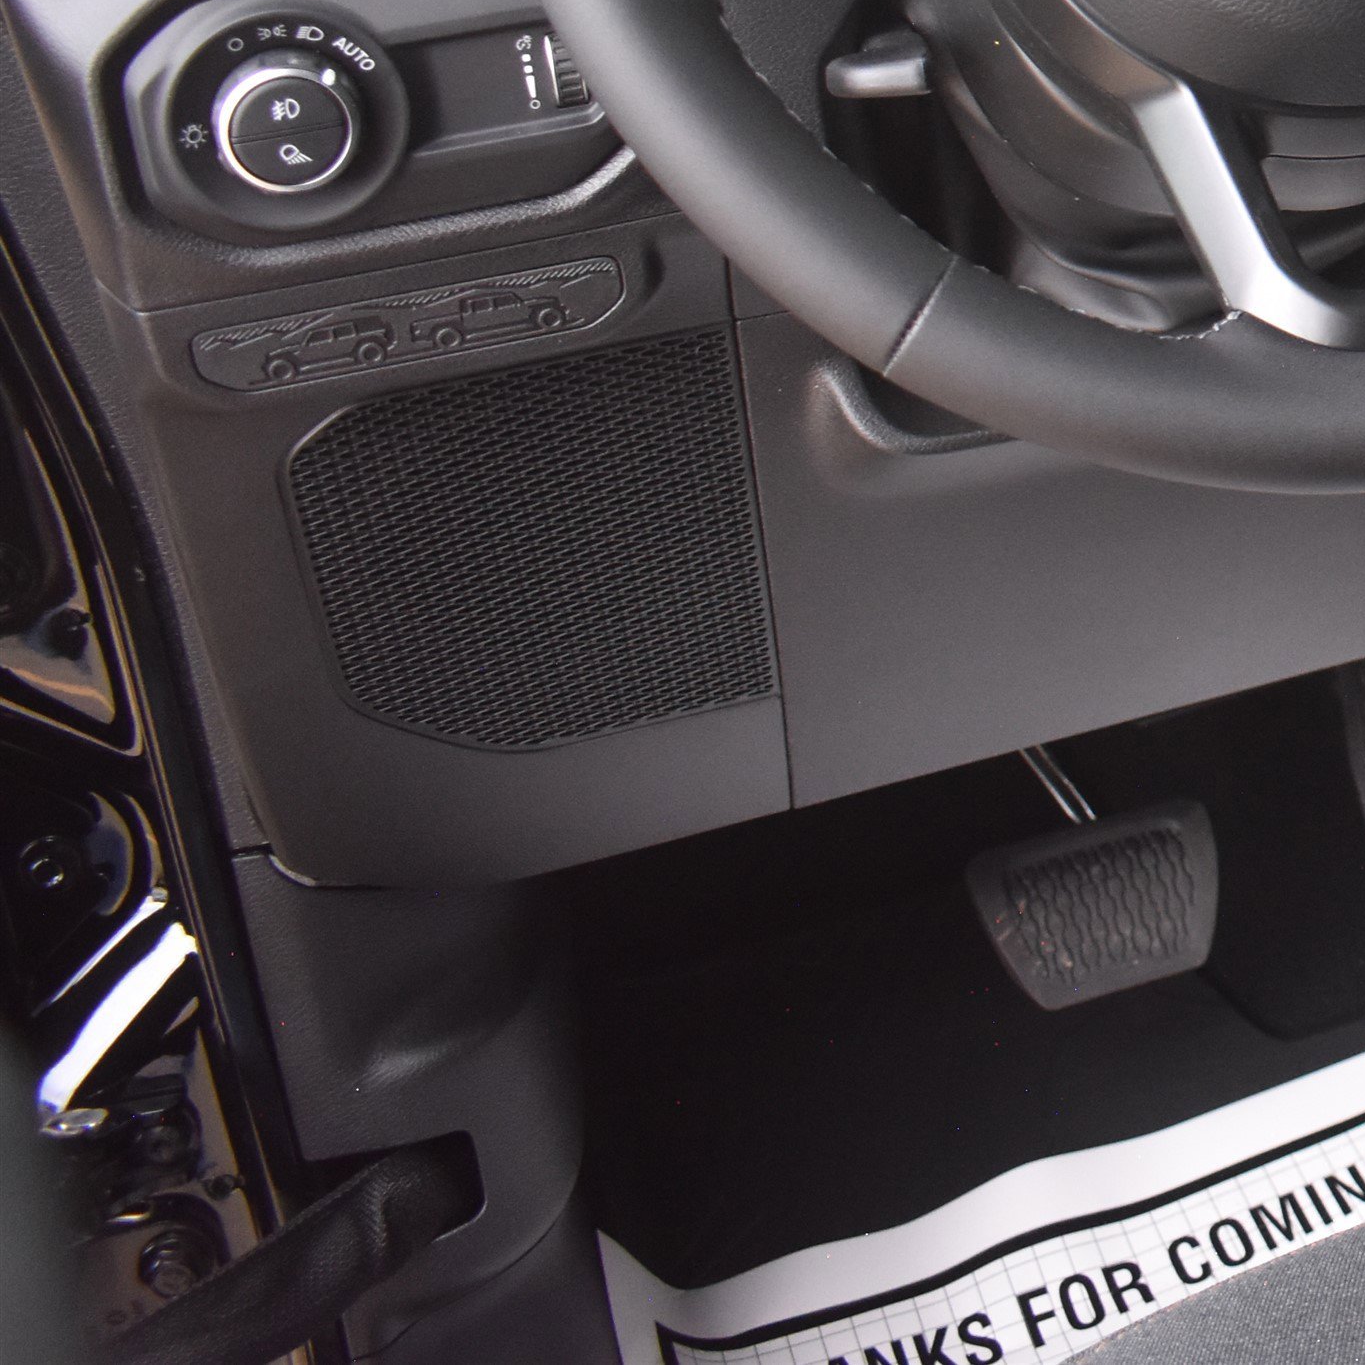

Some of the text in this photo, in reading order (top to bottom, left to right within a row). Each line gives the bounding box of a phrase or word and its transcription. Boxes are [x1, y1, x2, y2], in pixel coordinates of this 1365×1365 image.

[332, 37, 376, 72] AUTO
[827, 1313, 1003, 1365] NKS
[1017, 1262, 1155, 1348] FOR
